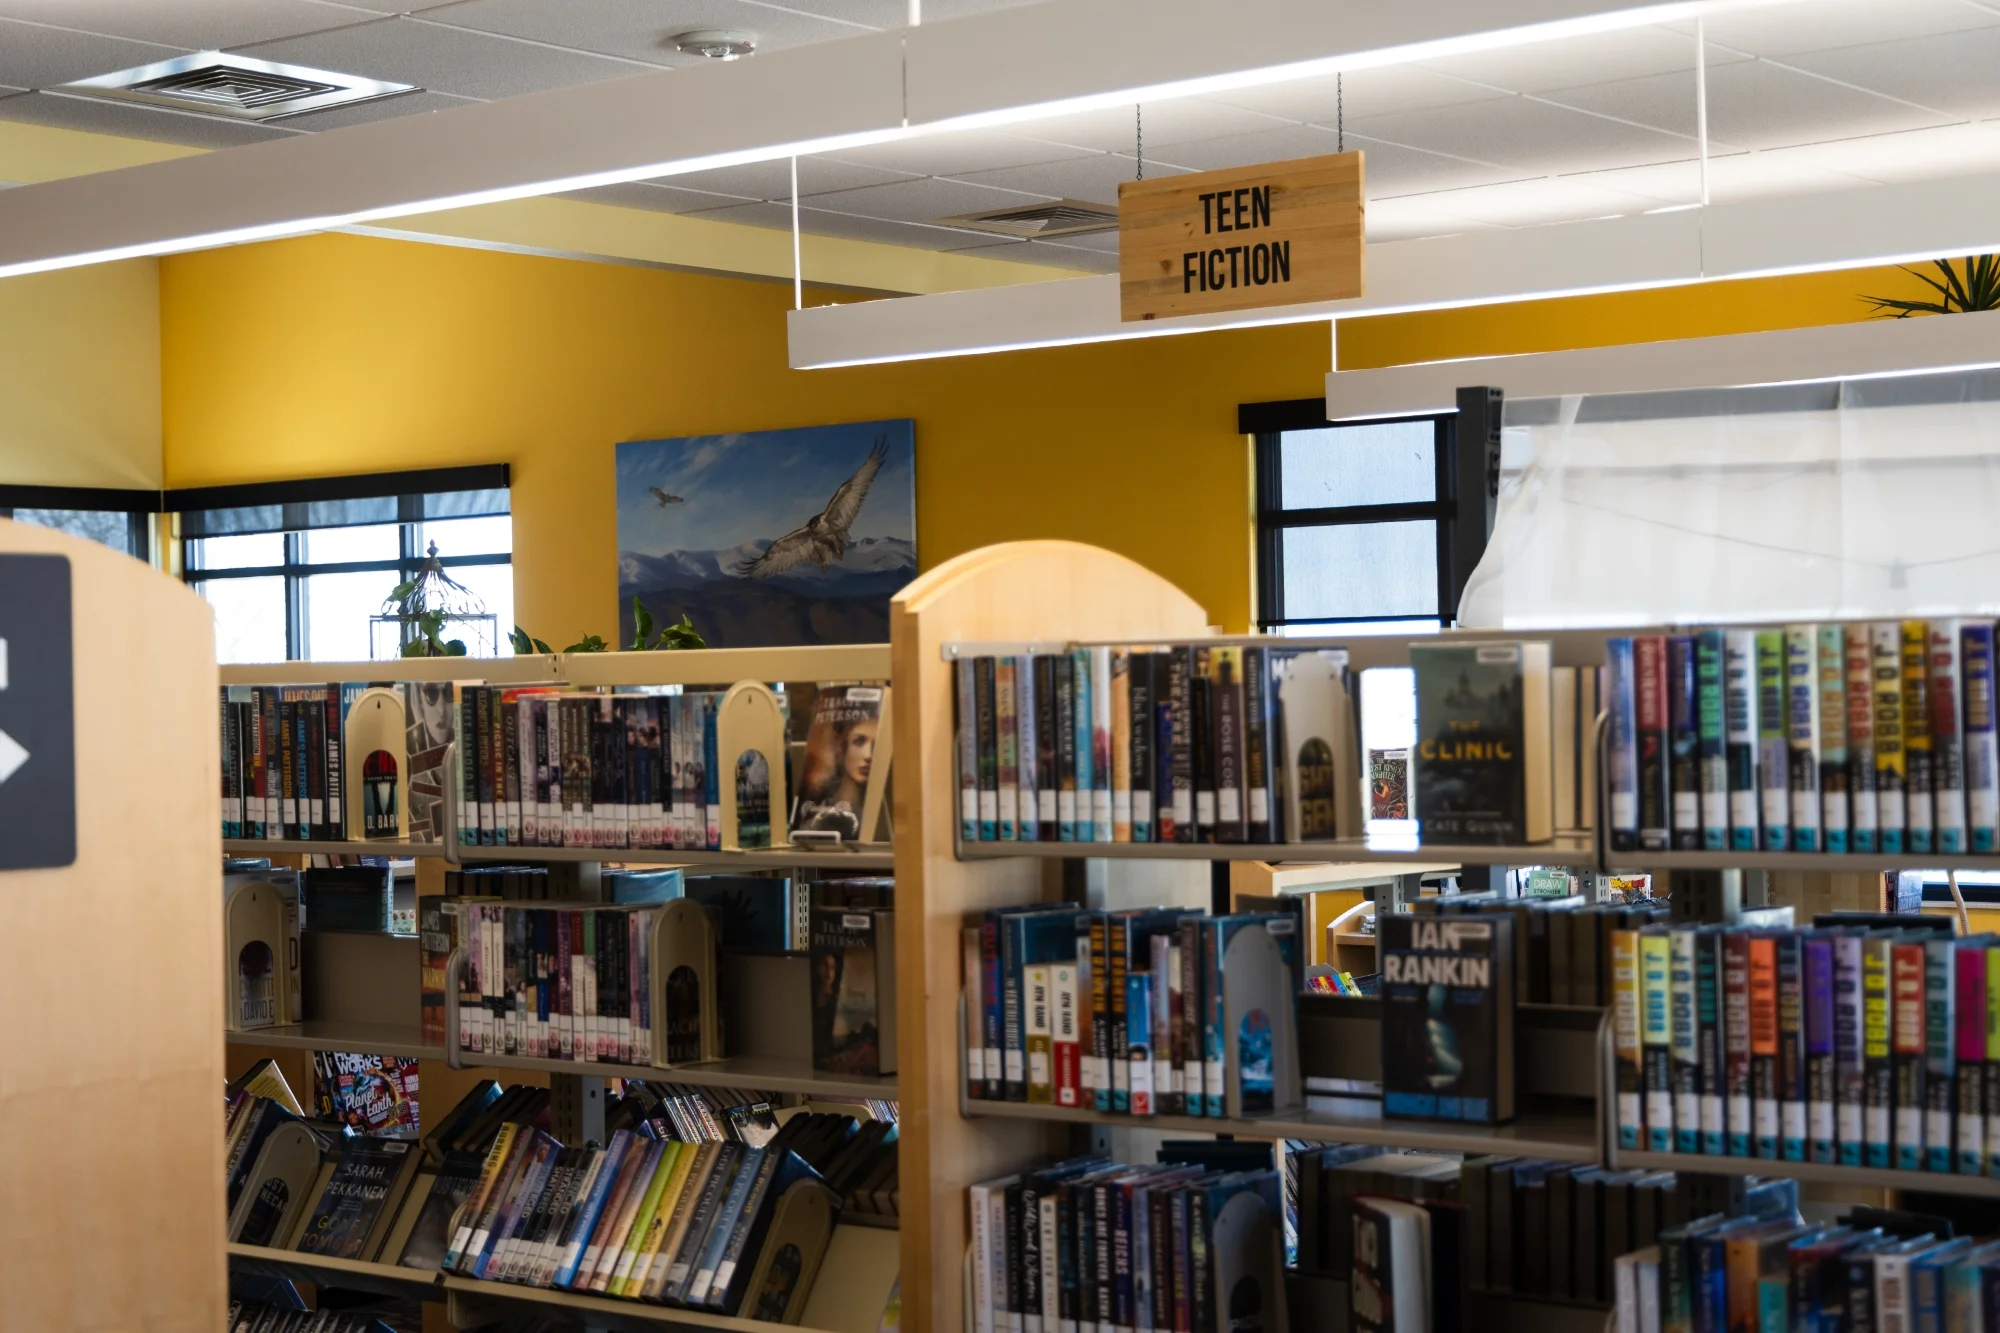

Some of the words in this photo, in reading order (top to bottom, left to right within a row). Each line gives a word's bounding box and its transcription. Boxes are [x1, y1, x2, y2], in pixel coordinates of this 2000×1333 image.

[1199, 185, 1270, 234] TEEN
[1184, 241, 1290, 293] FICTION
[252, 693, 260, 715] JAMES
[266, 694, 276, 716] JAMES
[1698, 684, 1722, 739] ROBB
[1789, 684, 1812, 740] ROBB
[1847, 682, 1870, 739] ROBB
[228, 718, 237, 747] JAMES
[252, 716, 261, 755] PATTERSON
[266, 718, 277, 756] PATTERSON
[281, 719, 291, 747] JAMES
[298, 719, 308, 750] JAMES
[1222, 714, 1232, 753] ROSE
[1876, 692, 1902, 753] ROBB
[328, 739, 340, 768] JAMES
[495, 723, 503, 754] PICNIC
[506, 715, 515, 779] OUTCAST
[1420, 739, 1513, 761] CLINIC
[228, 750, 238, 799] PATTERSON
[282, 750, 292, 798] PATTERSON
[495, 762, 503, 772] IN
[1222, 756, 1233, 788] COD
[1384, 764, 1404, 776] KING'S
[267, 770, 276, 796] MURDER
[329, 771, 341, 798] PATTE
[1424, 819, 1460, 833] CATE
[1533, 879, 1562, 888] DRAW
[421, 910, 440, 931] JAMES
[1411, 921, 1461, 950] IAN
[421, 931, 450, 953] PATTERSON
[1090, 925, 1106, 951] IAN
[1111, 925, 1126, 952] IAN
[1091, 956, 1107, 1014] RANKIN
[1111, 957, 1127, 1014] RANKIN
[1384, 955, 1491, 988] RANKIN
[1034, 985, 1046, 1003] AYN
[1062, 991, 1073, 1009] AYN
[244, 1000, 268, 1021] DAVID
[1034, 1004, 1047, 1029] RAND
[1062, 1011, 1074, 1035] RAND
[1615, 991, 1637, 1050] ROBB
[1646, 990, 1665, 1032] ROBB
[1672, 991, 1693, 1048] ROBB
[1725, 992, 1748, 1052] ROBB
[1896, 1000, 1920, 1047] ROBB
[1865, 997, 1888, 1058] ROBB
[336, 1056, 383, 1075] WORKS
[345, 1086, 379, 1111] Planet
[366, 1092, 394, 1117] Earth
[487, 1126, 510, 1168] BURNING
[715, 1144, 735, 1172] JODI
[345, 1163, 386, 1178] SARAH
[760, 1153, 776, 1177] Jodi
[326, 1181, 388, 1200] PEKKANEN
[521, 1164, 551, 1219] SUBMERGED
[537, 1165, 562, 1213] SHATTERED
[547, 1166, 575, 1215] STRANDED
[560, 1168, 588, 1214] SILENCED
[674, 1168, 697, 1219] PICOULT
[696, 1172, 722, 1221] PICOULT
[744, 1179, 766, 1213] Picoult
[1095, 1187, 1108, 1218] BONES
[317, 1215, 361, 1233] GONE
[1096, 1220, 1108, 1237] ARE
[1172, 1198, 1183, 1228] FIRE
[301, 1233, 363, 1252] TONIGHT
[1114, 1229, 1130, 1275] REICHS
[1096, 1240, 1109, 1281] FOREVER
[1174, 1253, 1186, 1300] BONES
[1098, 1286, 1110, 1317] KATHY
